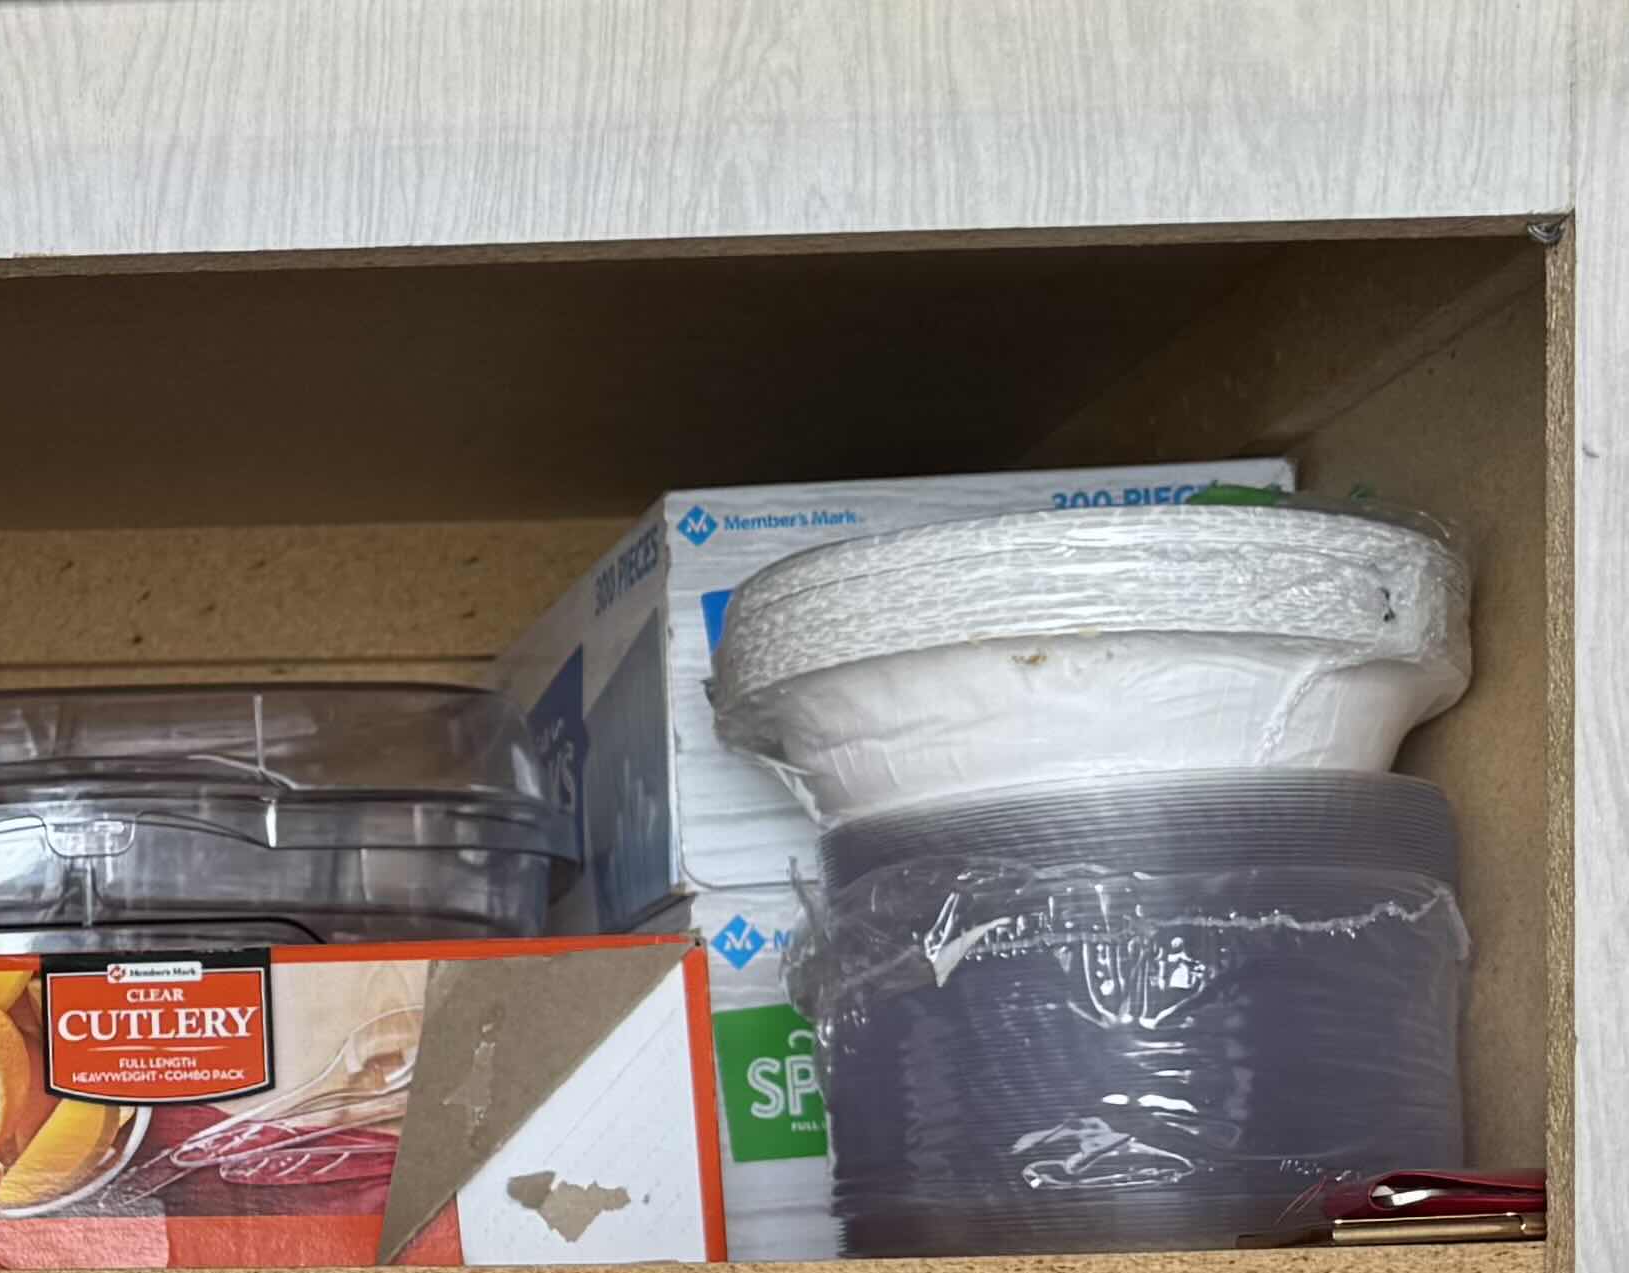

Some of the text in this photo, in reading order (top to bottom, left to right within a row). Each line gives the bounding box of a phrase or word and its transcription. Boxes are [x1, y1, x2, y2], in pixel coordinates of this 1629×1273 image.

[1051, 485, 1205, 509] 300 PIEC
[724, 510, 857, 531] Member's Mark
[614, 524, 658, 593] PIECES
[126, 988, 184, 1003] CLEAR
[57, 1006, 259, 1041] CUTLERY
[118, 1056, 197, 1069] FULL LENGTH
[71, 1068, 246, 1083] HEAVYWEIGHT COMBO PACK
